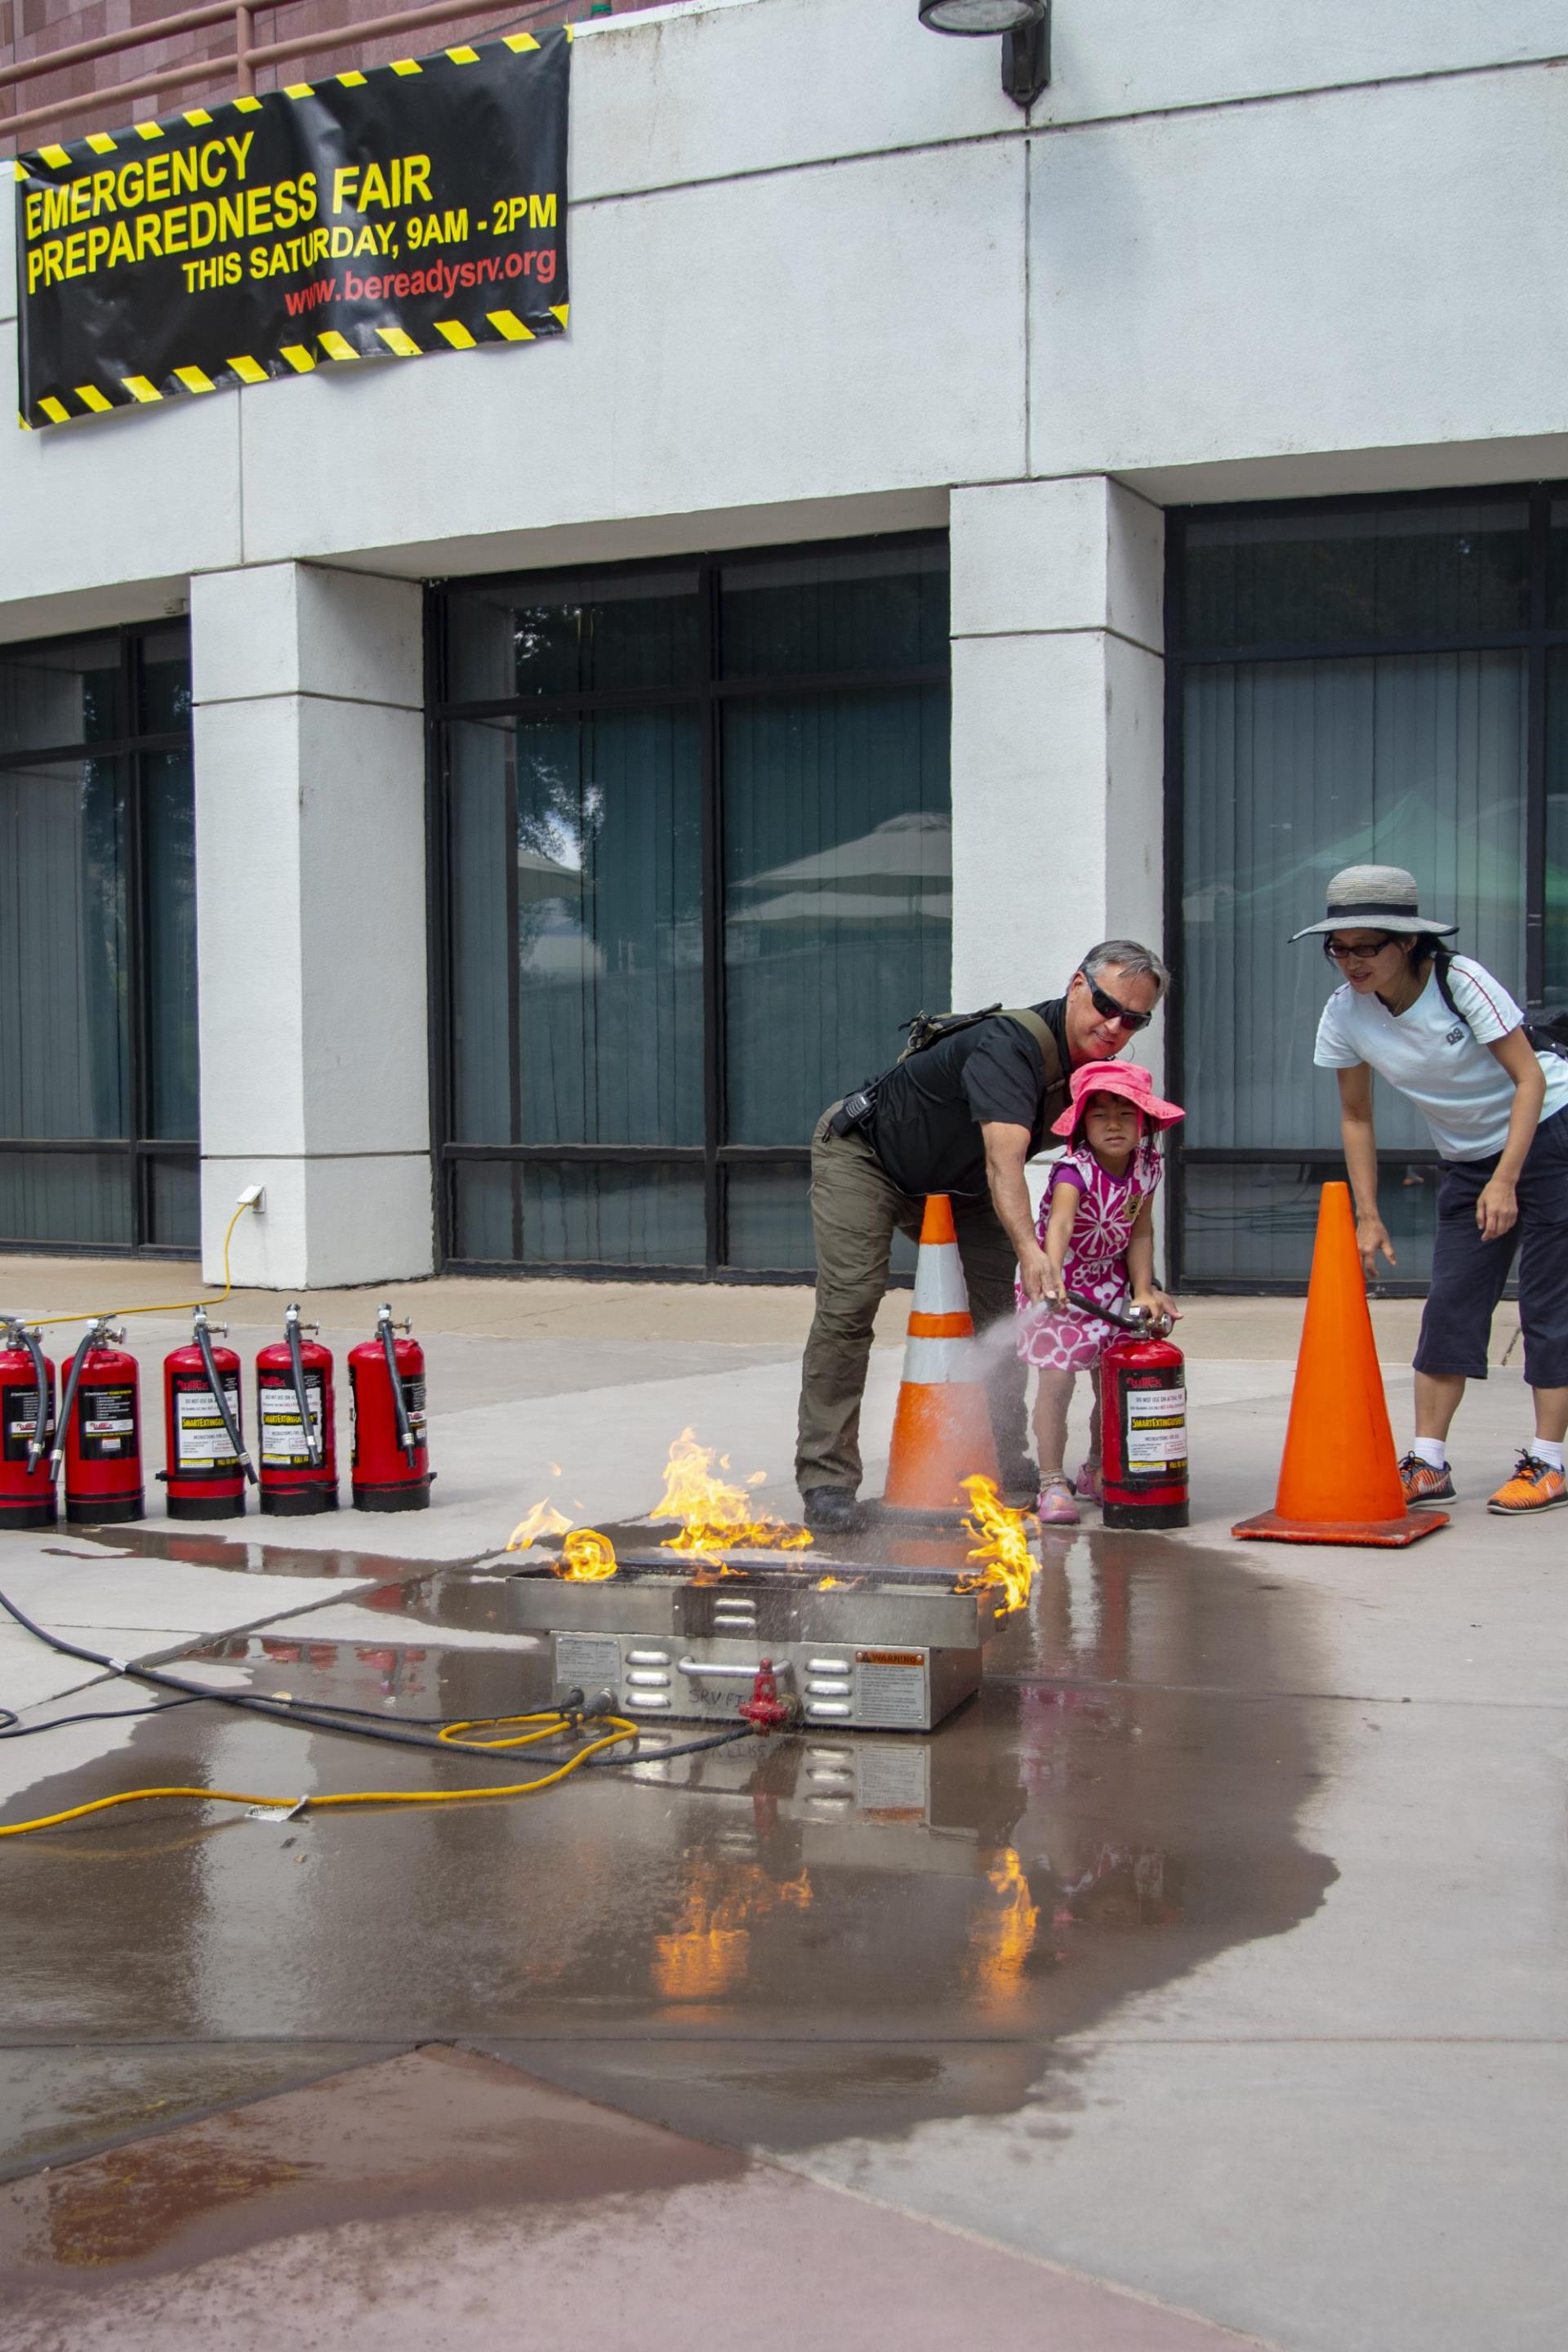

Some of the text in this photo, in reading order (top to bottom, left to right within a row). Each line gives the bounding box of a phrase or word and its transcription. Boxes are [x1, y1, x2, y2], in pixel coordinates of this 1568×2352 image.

[26, 131, 254, 241] EMERGENCY
[27, 154, 433, 295] PREPAREDNESS FAIR
[182, 193, 557, 293] THIS SATURDAY, 9AM - 2PM
[285, 248, 557, 316] www.bereadysrv.org
[688, 1688, 722, 1706] SRV
[872, 1654, 917, 1664] WARNING
